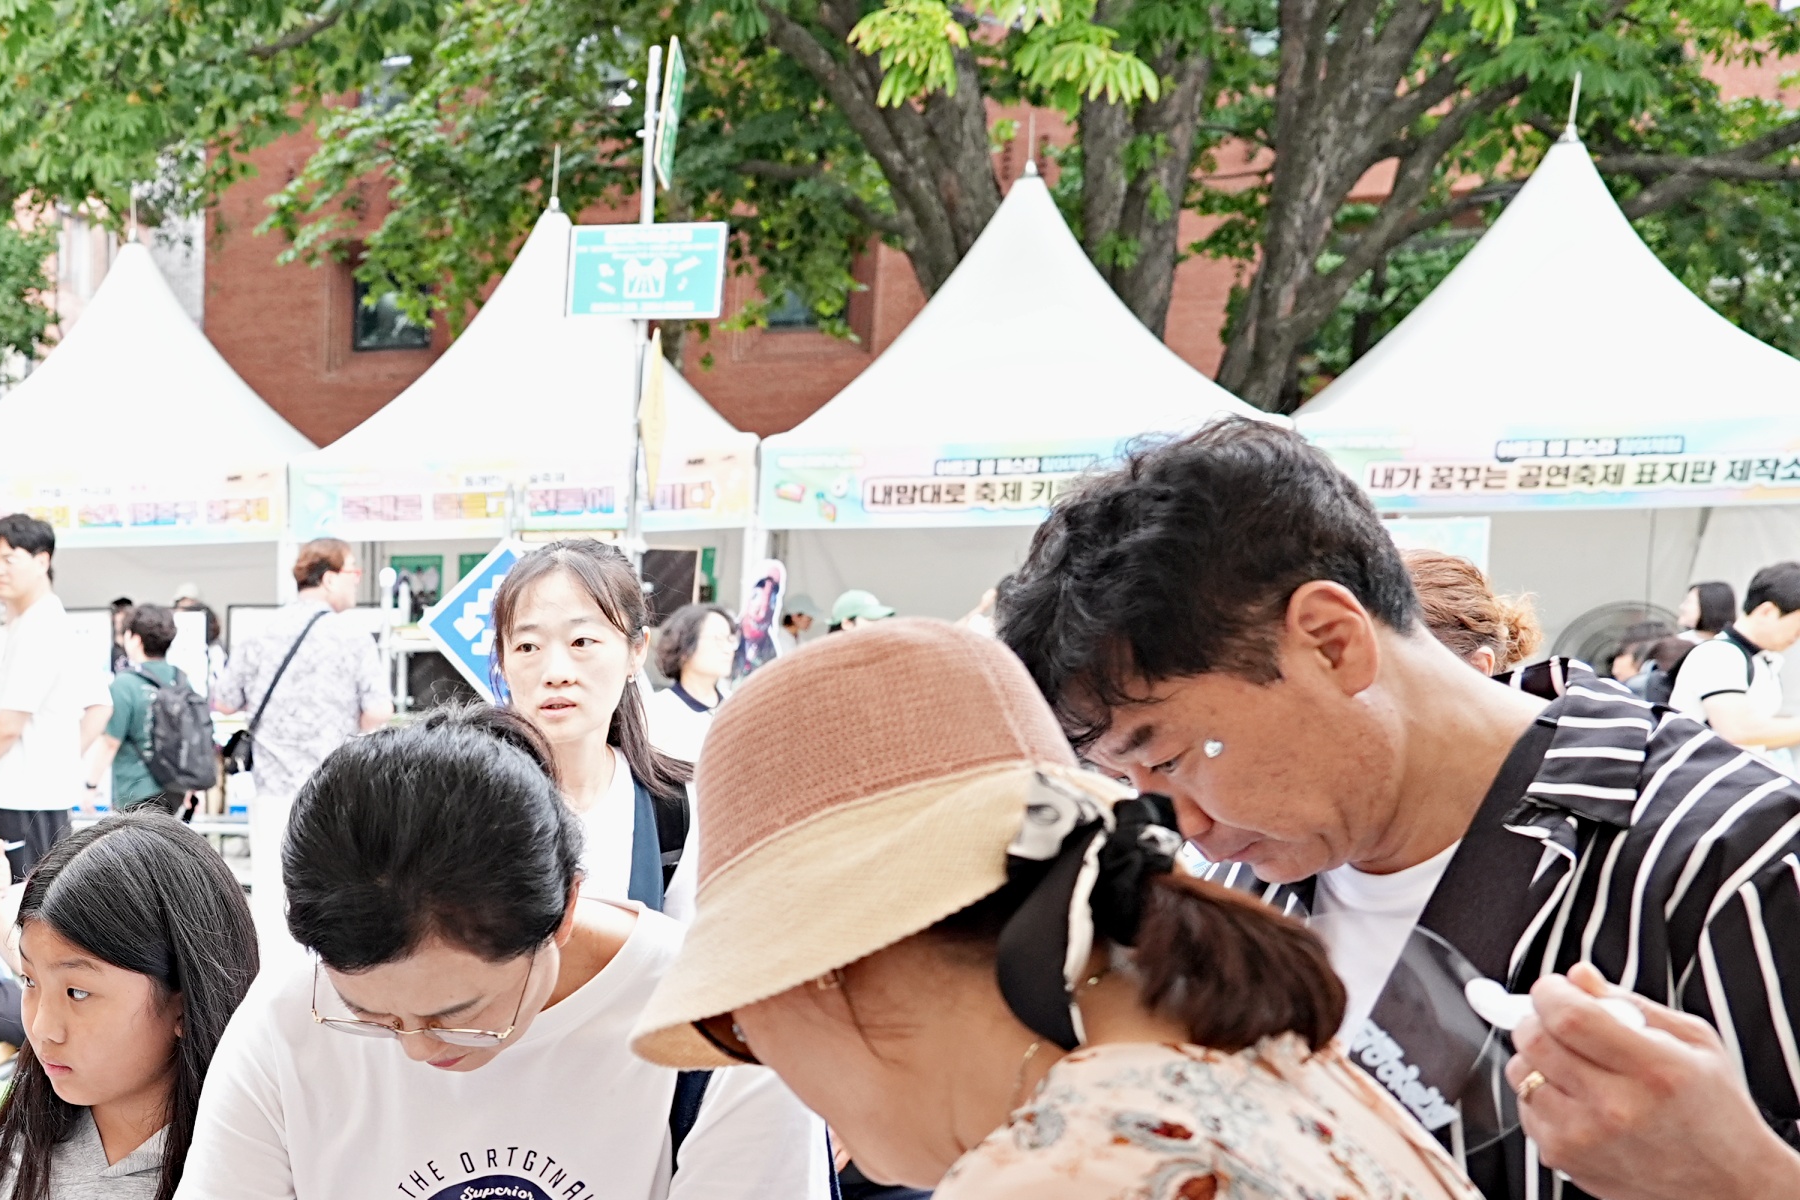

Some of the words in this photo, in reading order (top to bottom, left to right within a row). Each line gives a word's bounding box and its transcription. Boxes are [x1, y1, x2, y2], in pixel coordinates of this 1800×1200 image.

[1368, 465, 1422, 490] 내가
[1430, 463, 1507, 490] 꿈꾸는
[1517, 462, 1626, 489] 공연축제
[1634, 461, 1718, 487] 표지판
[870, 481, 966, 507] 내맘대로
[974, 480, 1022, 504] 축제
[397, 1160, 445, 1199] THE
